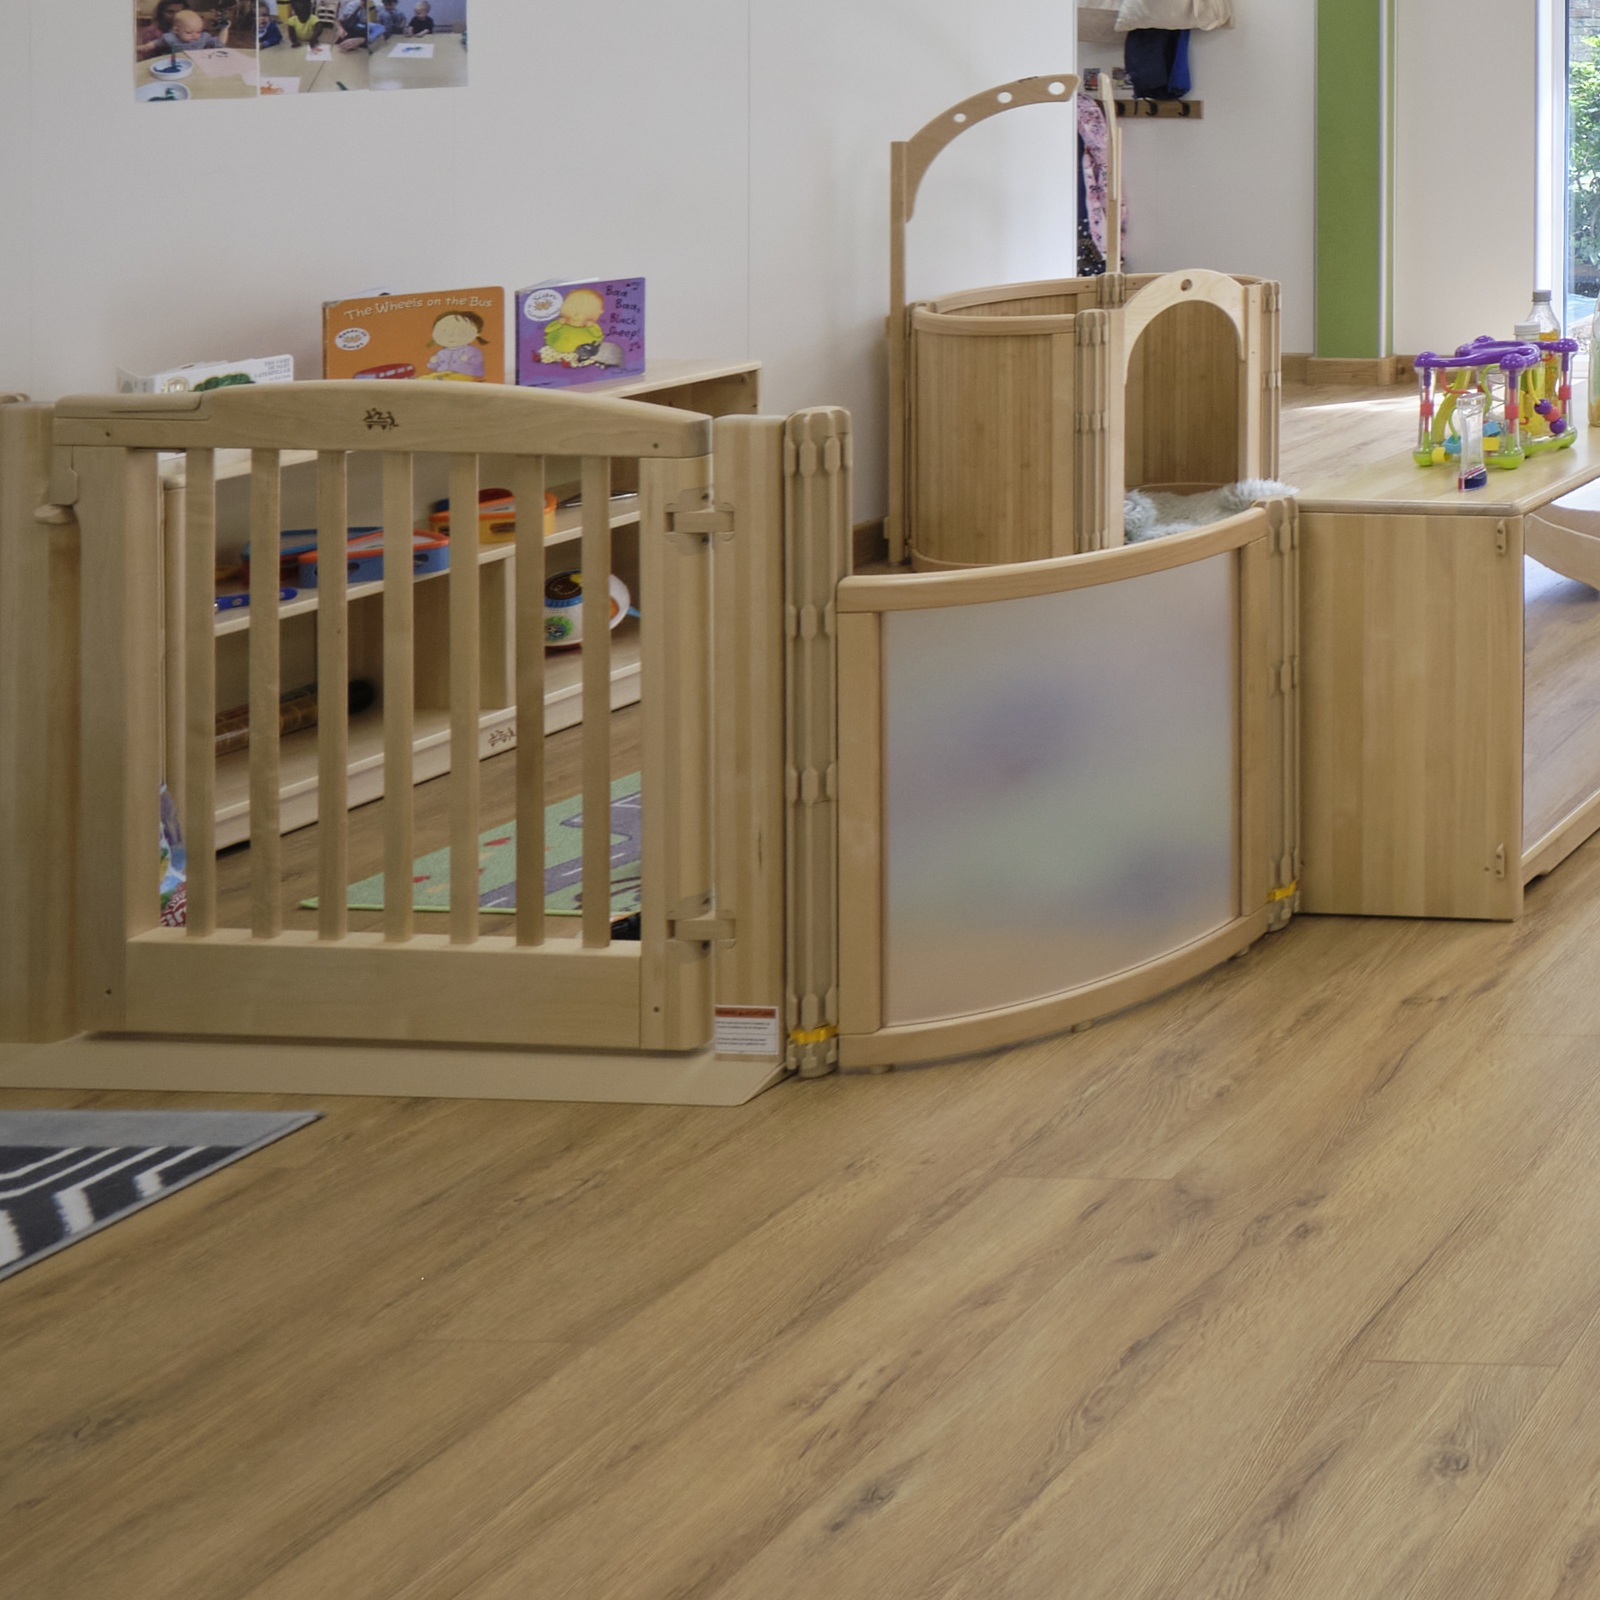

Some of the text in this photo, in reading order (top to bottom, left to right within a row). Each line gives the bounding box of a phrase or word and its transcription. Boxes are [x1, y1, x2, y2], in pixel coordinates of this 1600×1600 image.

[606, 284, 629, 298] Baa
[344, 295, 493, 321] The Wheels on the Bus
[609, 312, 638, 325] Black
